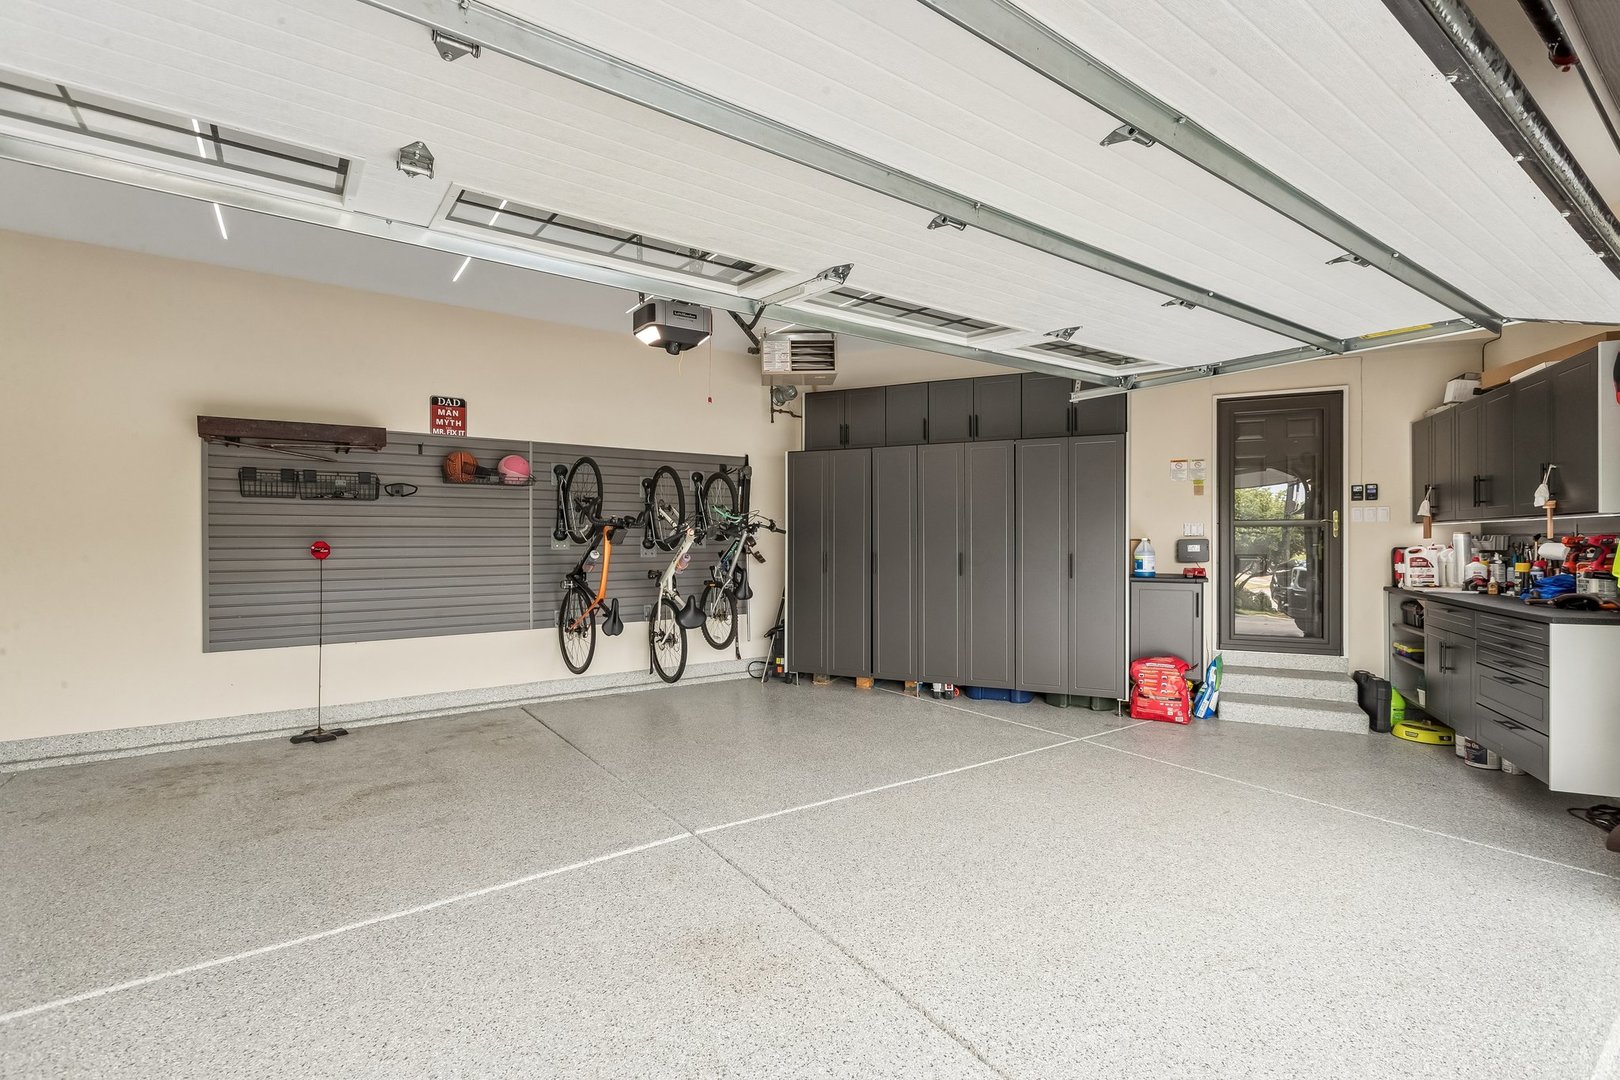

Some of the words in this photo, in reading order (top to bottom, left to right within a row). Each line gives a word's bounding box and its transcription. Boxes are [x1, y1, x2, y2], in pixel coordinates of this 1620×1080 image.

[438, 398, 461, 406] DAD
[438, 408, 458, 416] MAN
[436, 418, 462, 426] MYTH
